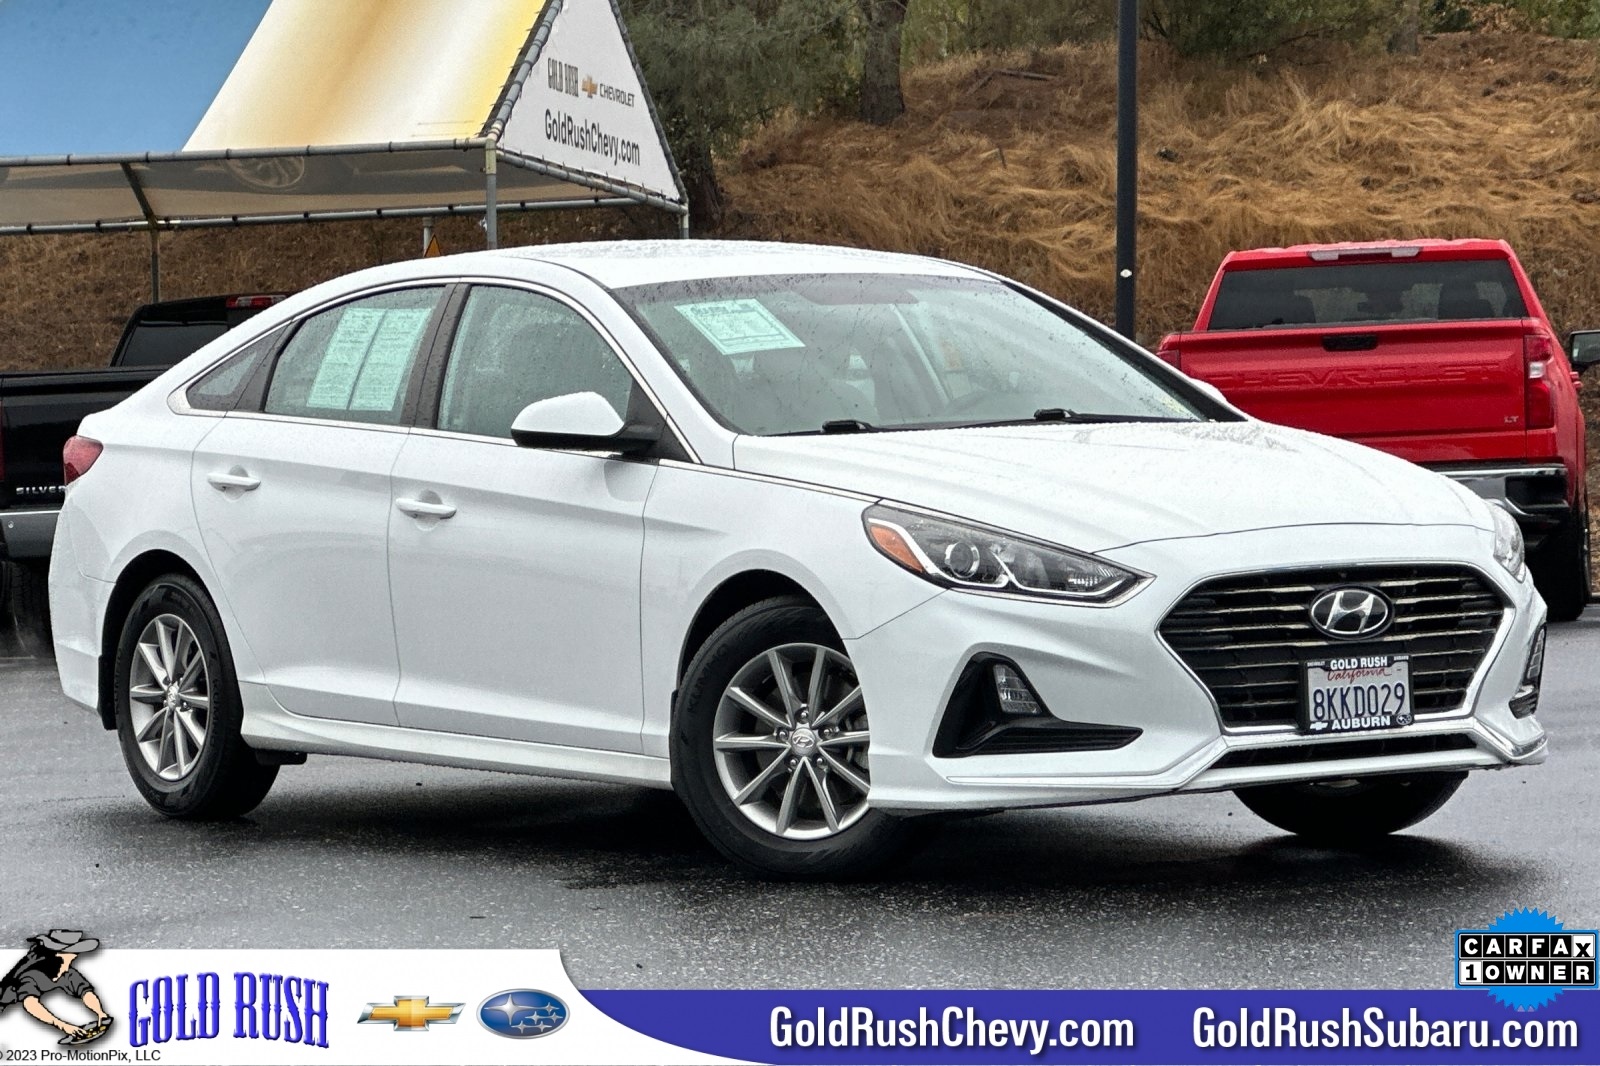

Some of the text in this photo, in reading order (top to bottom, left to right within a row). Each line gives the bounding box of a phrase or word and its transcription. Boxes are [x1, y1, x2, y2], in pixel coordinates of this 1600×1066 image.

[600, 83, 635, 107] CHEVROLET
[545, 108, 640, 165] GoldRushChevy.com
[1330, 658, 1359, 670] GOLD
[1361, 656, 1388, 668] RUSH
[1327, 668, 1393, 684] California
[1313, 682, 1406, 721] 8KKD029
[1331, 716, 1391, 730] AUBURN
